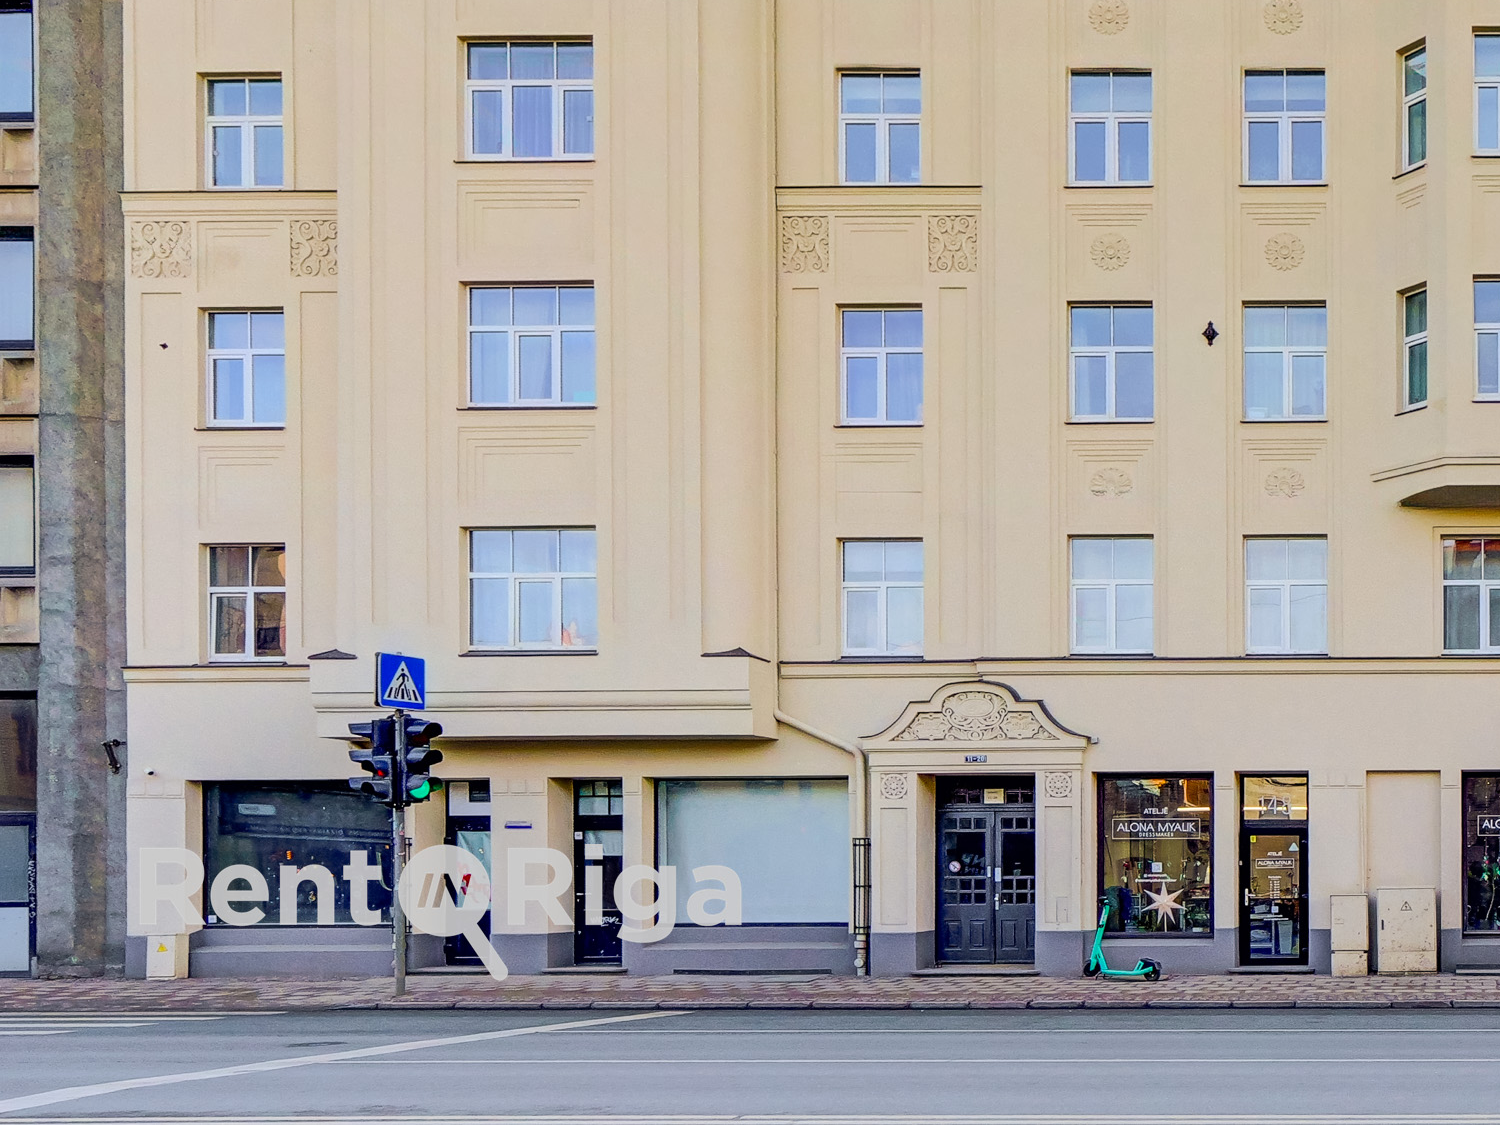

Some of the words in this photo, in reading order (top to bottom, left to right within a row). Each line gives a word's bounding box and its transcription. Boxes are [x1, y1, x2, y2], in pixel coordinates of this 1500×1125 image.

[1259, 796, 1291, 815] 148
[1143, 807, 1168, 815] ATELJĒ
[1116, 822, 1154, 832] ALONA
[1158, 822, 1197, 832] MYALIK
